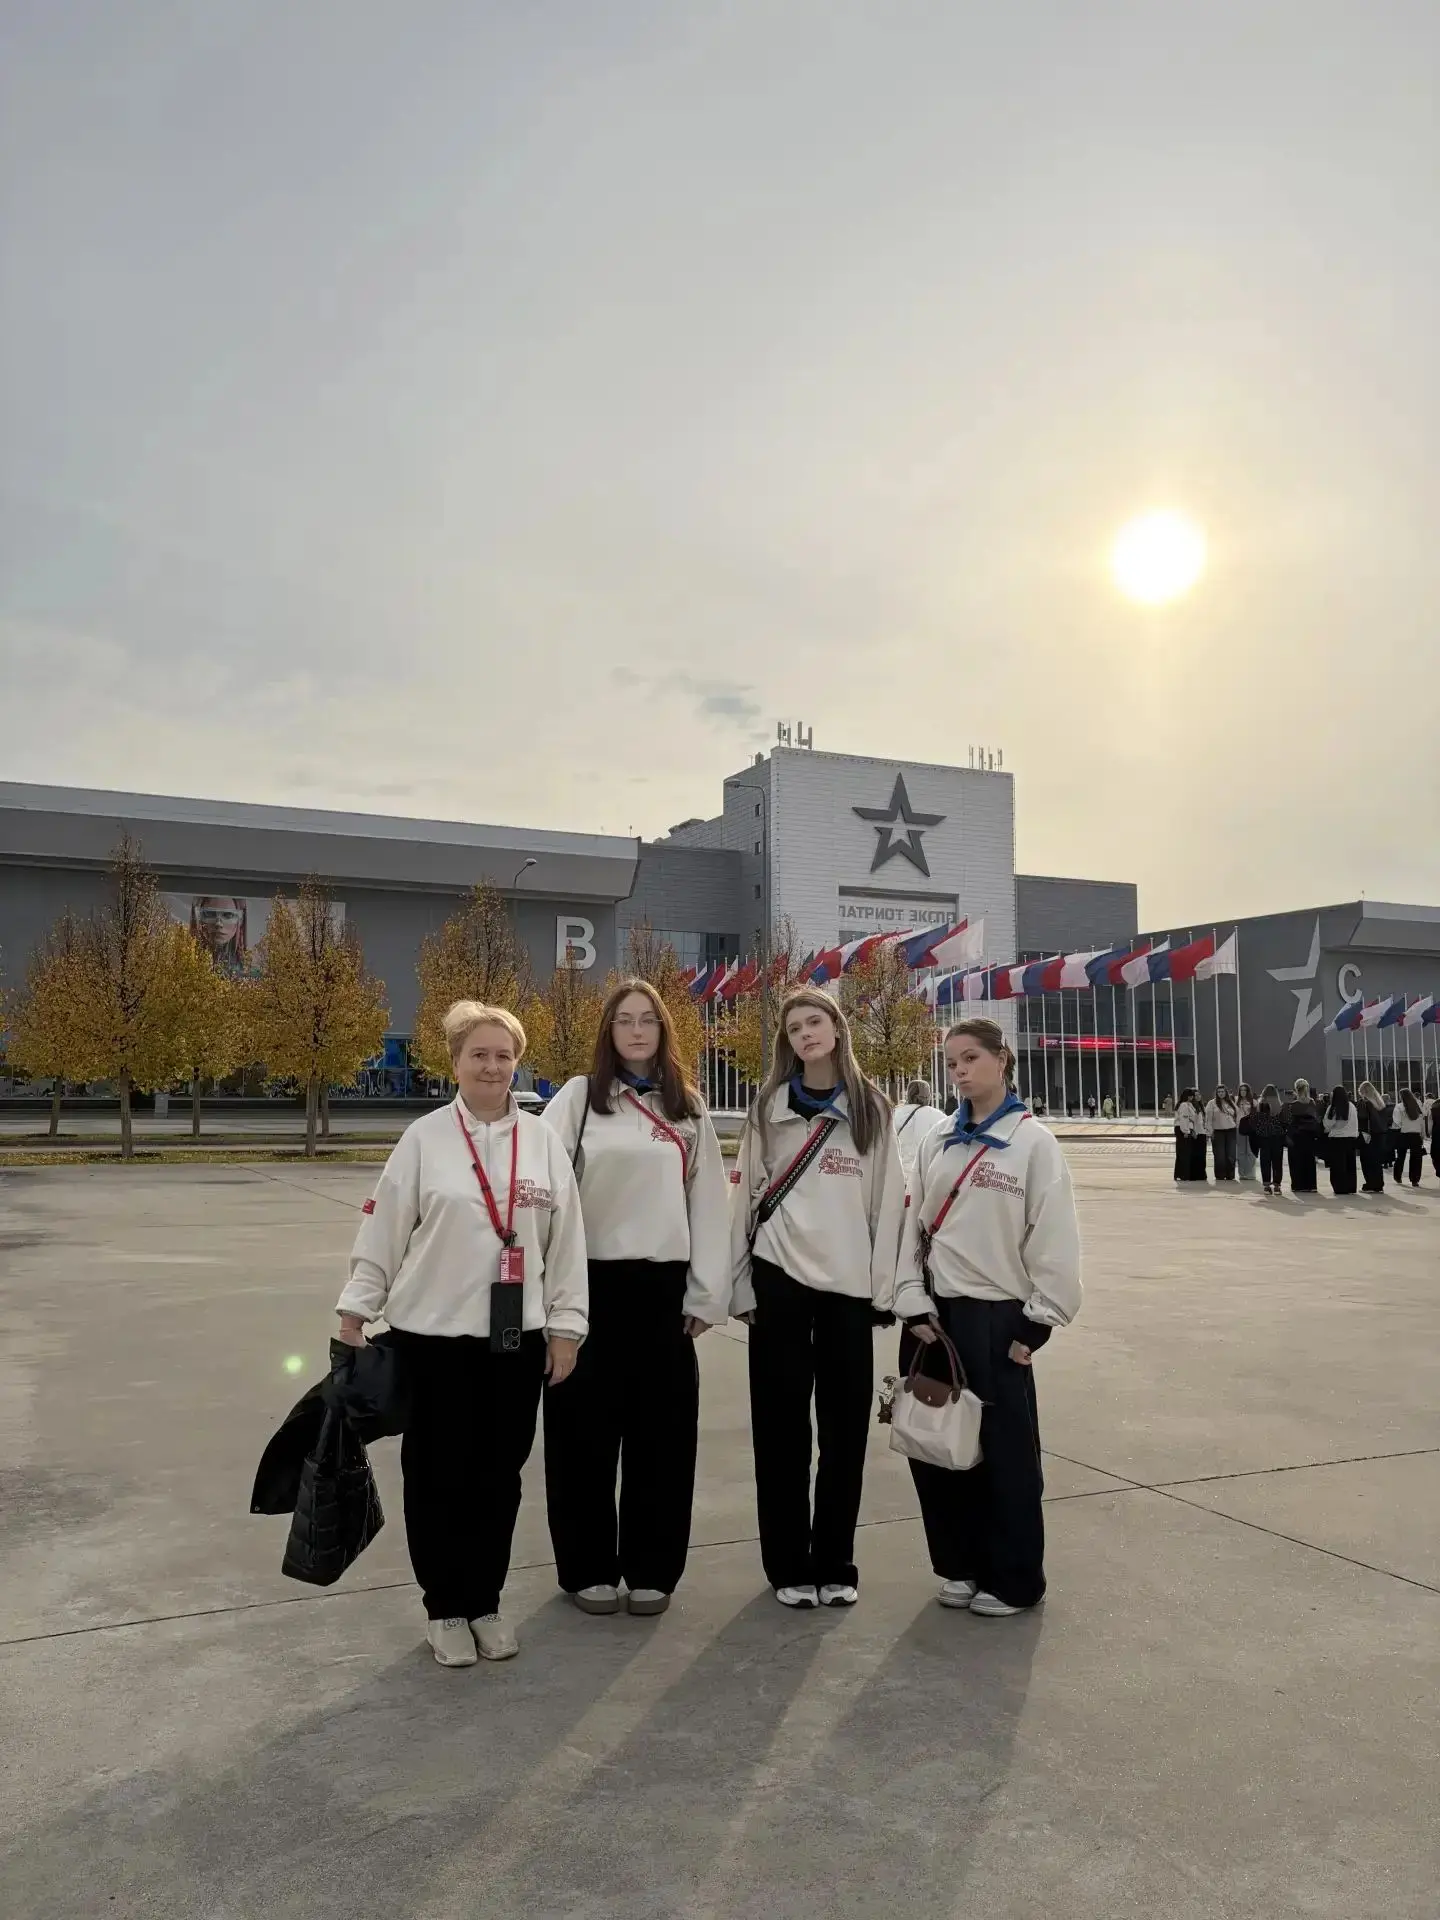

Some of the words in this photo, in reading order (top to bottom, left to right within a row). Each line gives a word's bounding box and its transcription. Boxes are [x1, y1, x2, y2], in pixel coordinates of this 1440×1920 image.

[838, 905, 904, 921] ПАТРИОТ
[909, 909, 957, 924] ЭКСПО
[556, 915, 597, 970] B
[1338, 963, 1363, 1004] C
